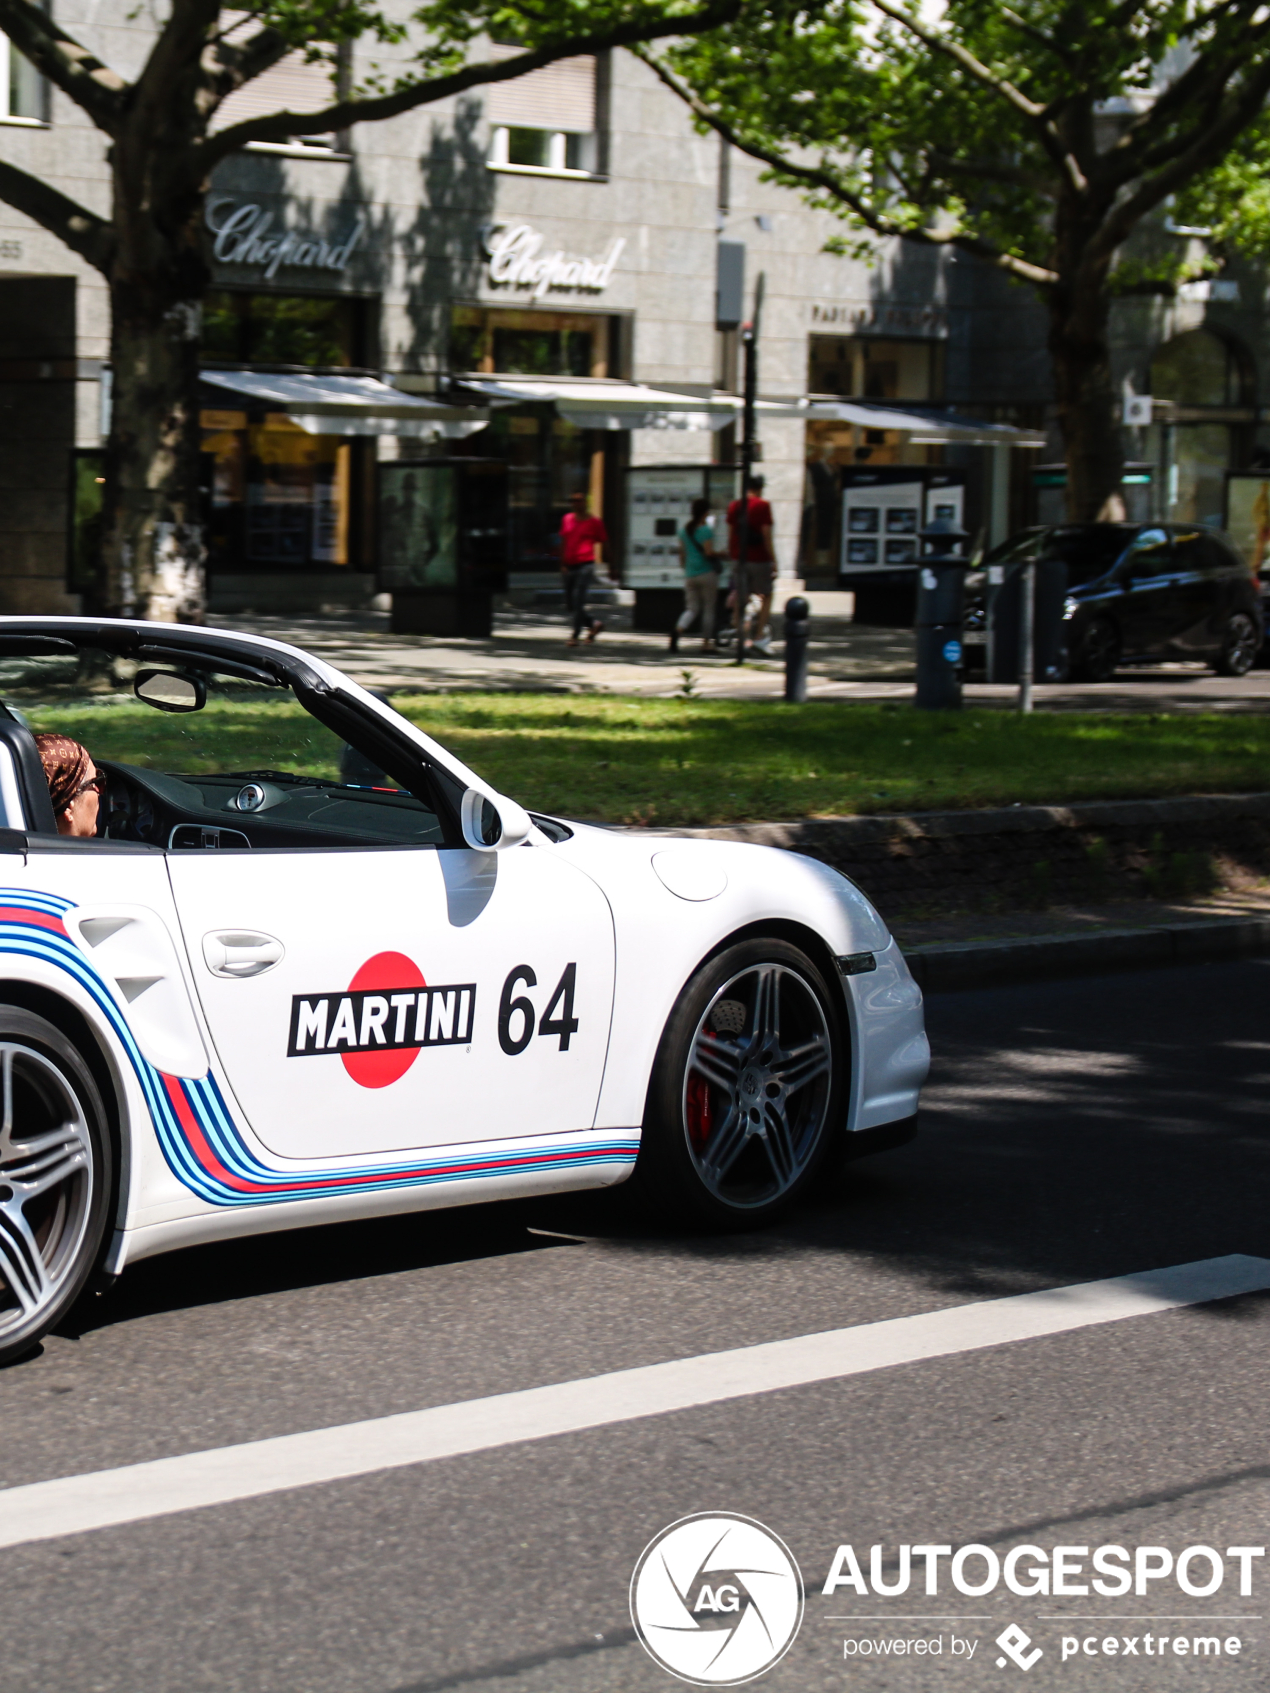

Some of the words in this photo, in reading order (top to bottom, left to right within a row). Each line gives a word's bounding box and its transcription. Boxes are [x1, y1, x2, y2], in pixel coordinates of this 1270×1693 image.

[205, 198, 366, 279] Chopard
[483, 219, 627, 298] Chopard
[295, 989, 471, 1051] MARTINI
[497, 962, 579, 1056] 64
